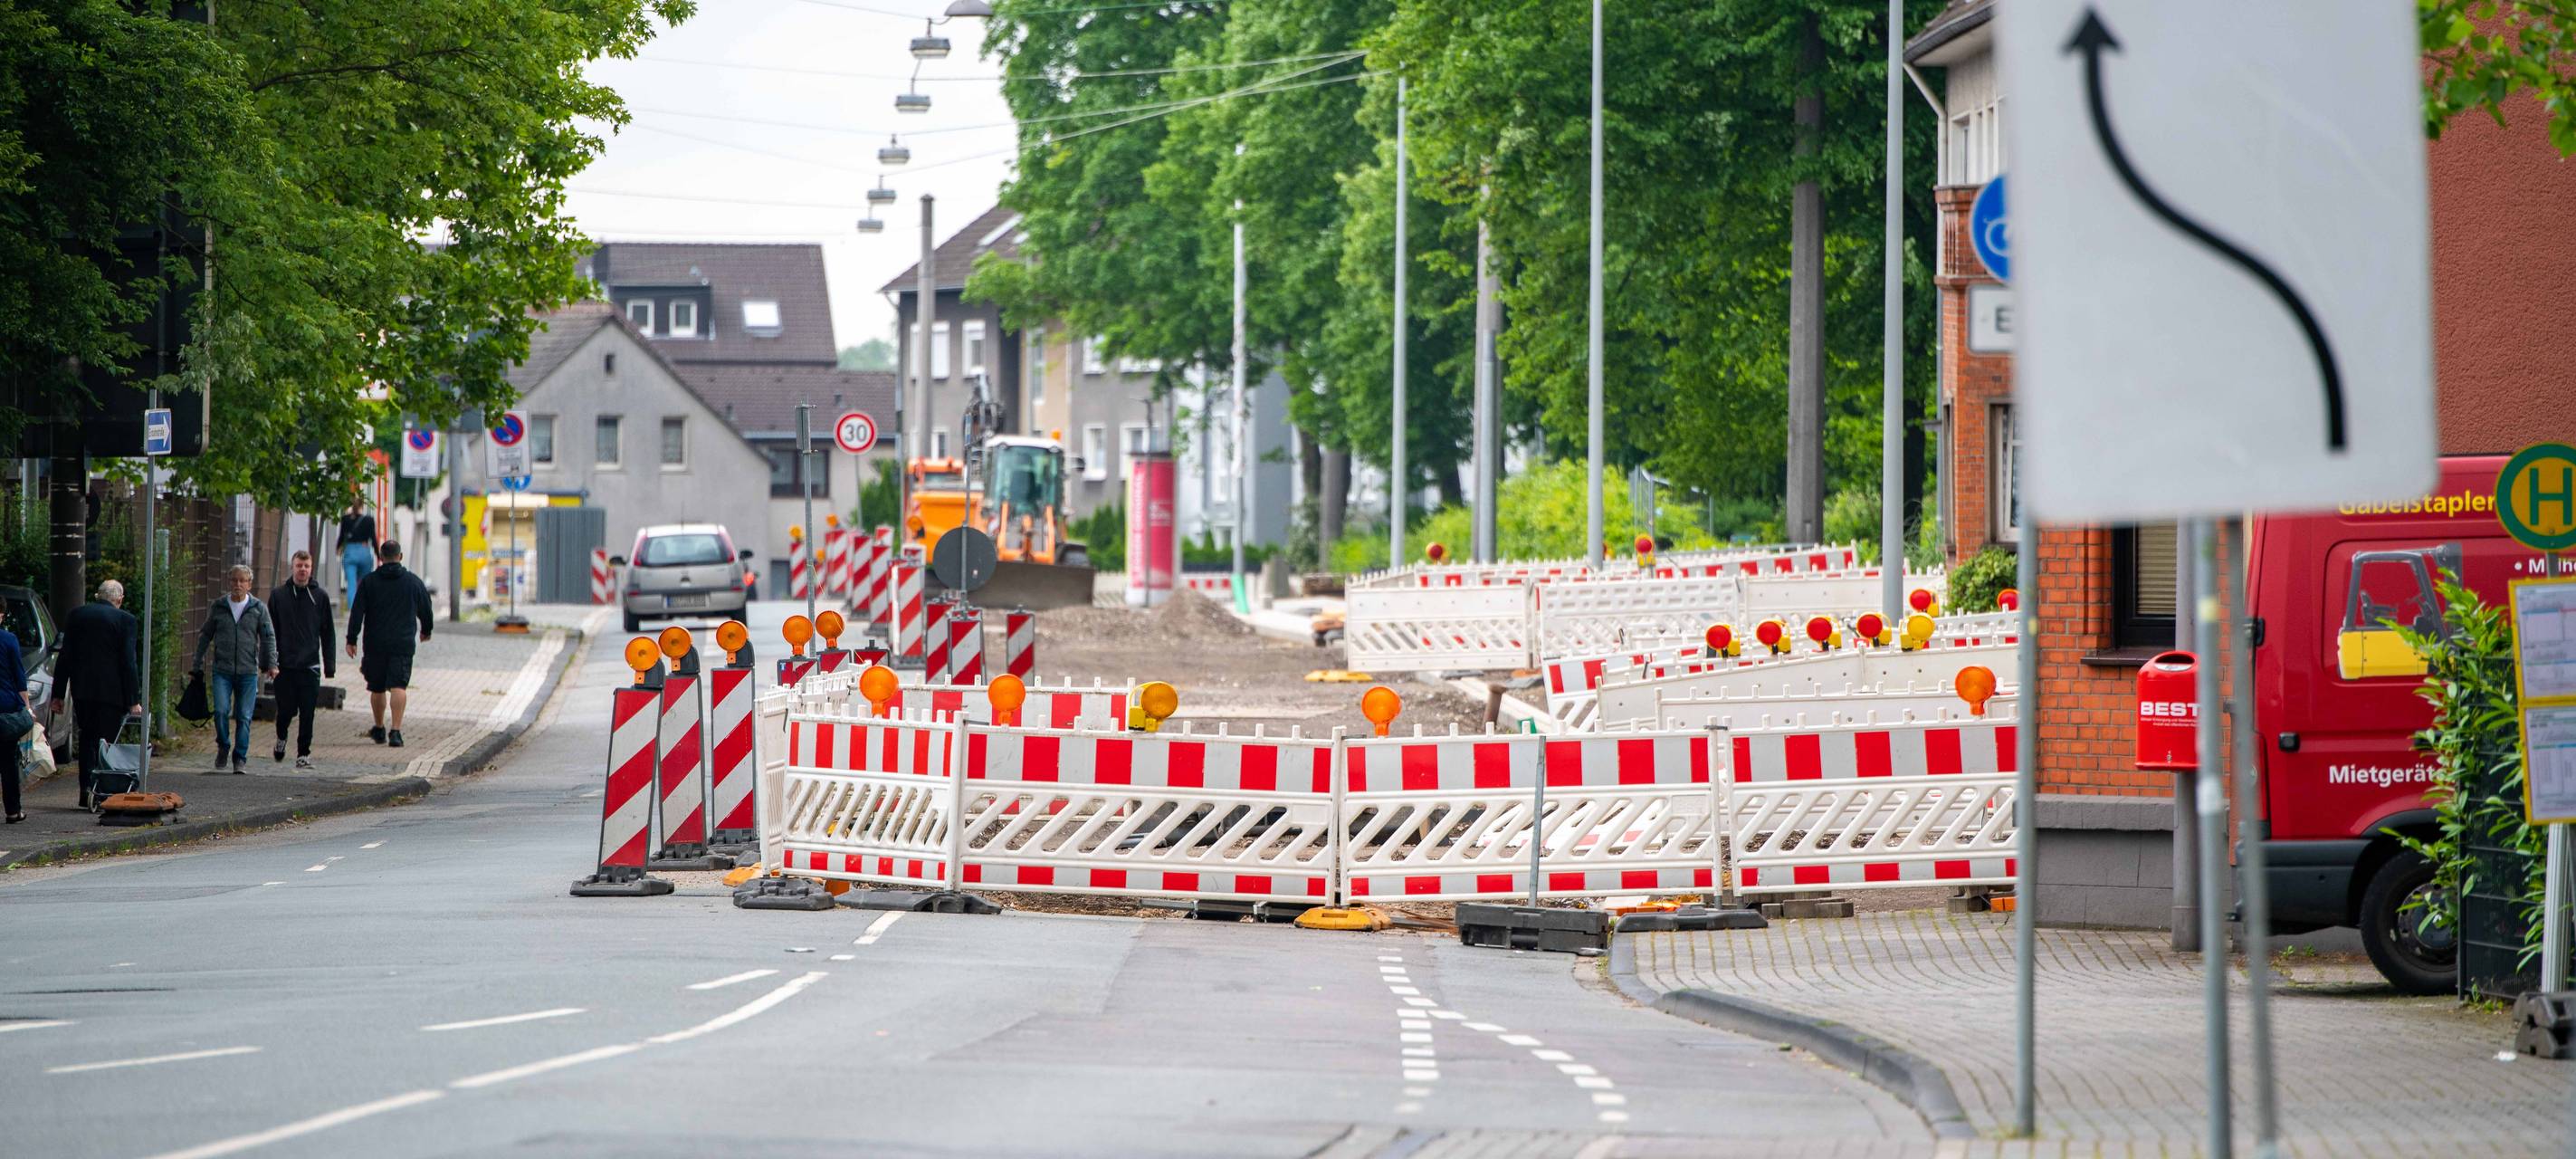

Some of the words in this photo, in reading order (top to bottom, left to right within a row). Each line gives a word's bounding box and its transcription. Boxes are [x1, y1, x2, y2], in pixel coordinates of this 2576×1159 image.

[844, 424, 867, 442] 30
[2530, 467, 2572, 525] H
[2141, 701, 2200, 717] BEST
[2329, 764, 2447, 787] Mietgerät
